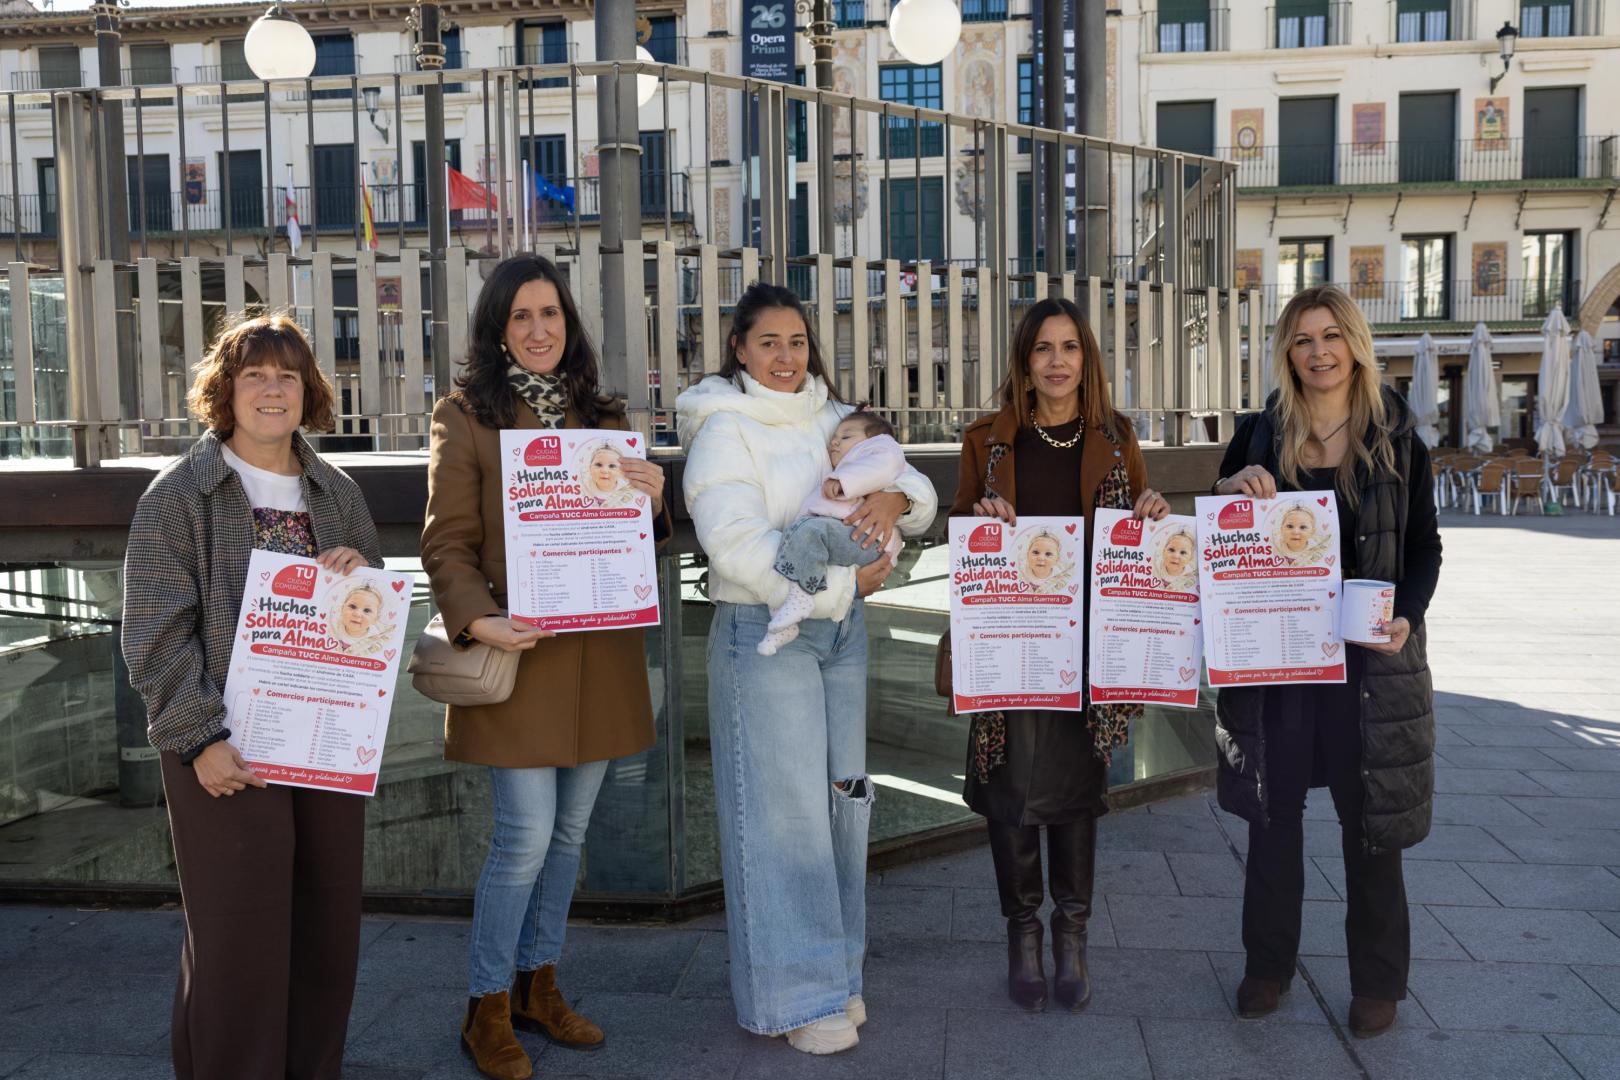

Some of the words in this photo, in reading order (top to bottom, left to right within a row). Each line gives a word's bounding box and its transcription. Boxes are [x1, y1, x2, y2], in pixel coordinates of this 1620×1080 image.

[751, 4, 786, 28] 26
[750, 34, 786, 45] Opera
[751, 44, 785, 54] Prima
[541, 439, 558, 448] TU
[517, 467, 569, 483] Huchas
[509, 482, 581, 500] Solidarias
[517, 499, 543, 512] para
[545, 495, 583, 509] Alma
[1234, 502, 1250, 512] TU
[984, 526, 999, 535] TU
[1127, 520, 1142, 529] TU
[1211, 531, 1261, 546] Huchas
[578, 548, 621, 557] participantes
[1103, 548, 1144, 560] Huchas
[1203, 543, 1272, 561] Solidarias
[962, 554, 1007, 569] Huchas
[1096, 560, 1152, 576] Solidarias
[1210, 559, 1235, 571] para
[1237, 555, 1275, 568] Alma
[296, 566, 314, 579] TU
[954, 567, 1018, 585] Solidarias
[274, 582, 310, 593] COMERCIAL
[287, 578, 311, 586] CIUDAD
[961, 583, 982, 596] para
[984, 580, 1020, 593] Alma
[1100, 575, 1120, 587] para
[1120, 573, 1153, 588] Alma
[259, 597, 317, 617] Huchas
[1268, 605, 1310, 614] participantes
[245, 613, 327, 635] Solidarias
[252, 628, 281, 642] para
[282, 630, 326, 650] Alma
[262, 646, 297, 658] Campaña
[298, 651, 320, 660] TUCC
[321, 654, 340, 663] Alma
[340, 656, 372, 667] Guerrera
[266, 690, 304, 701] Comercios
[307, 695, 355, 708] participantes
